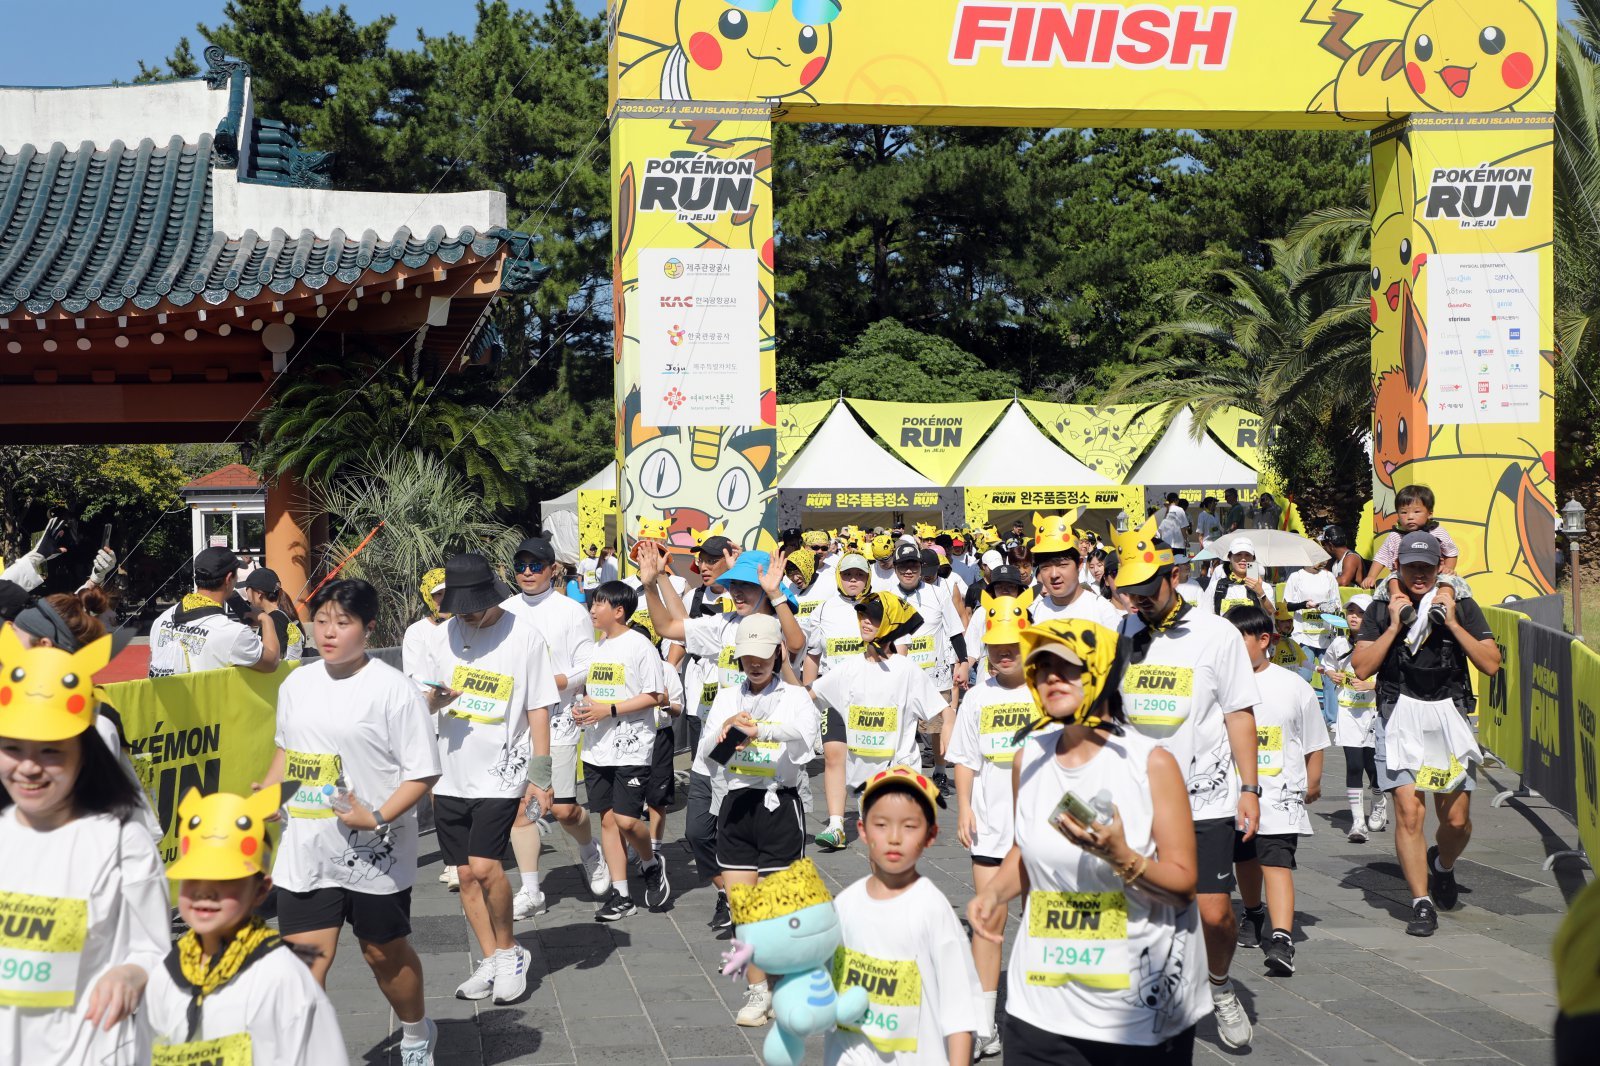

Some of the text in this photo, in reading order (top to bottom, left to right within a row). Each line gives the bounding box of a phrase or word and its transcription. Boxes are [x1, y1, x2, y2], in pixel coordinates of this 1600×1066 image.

[953, 5, 1232, 65] FINISH
[678, 106, 703, 114] JEJU
[704, 106, 739, 115] ISLAND
[1466, 117, 1490, 125] JEJU
[1490, 117, 1524, 125] ISLAND
[646, 154, 753, 175] POKÉMON
[1432, 163, 1533, 183] POKÉMON
[639, 176, 752, 211] RUN
[1425, 184, 1532, 218] RUN
[690, 213, 716, 221] JEJU
[1472, 219, 1497, 227] JEJU
[686, 263, 731, 273] 제주관광공사
[660, 296, 693, 308] KAC
[687, 332, 730, 341] 한국관광공사
[665, 363, 686, 375] Jeju
[902, 414, 962, 426] POKÉMON
[900, 427, 963, 448] RUN
[805, 497, 832, 507] RUN
[835, 492, 910, 508] 완주품증정소
[912, 496, 939, 506] RUN
[991, 495, 1016, 504] RUN
[1020, 491, 1091, 505] 완주품증정소
[1094, 494, 1119, 503] RUN
[1178, 493, 1202, 502] RUN
[834, 643, 860, 652] RUN
[467, 671, 500, 683] POKÉMON
[591, 670, 614, 681] RUN
[1139, 669, 1177, 677] POKÉMON
[462, 677, 499, 694] RUN
[1136, 676, 1177, 690] RUN
[457, 696, 496, 713] I-2637
[993, 707, 1030, 715] POKÉMON
[1134, 699, 1177, 712] I-2906
[857, 716, 885, 728] RUN
[991, 713, 1031, 728] RUN
[1530, 687, 1560, 757] RUN
[131, 720, 221, 765] KÉMON
[855, 733, 885, 746] I-2612
[734, 750, 771, 764] I-2854
[287, 763, 321, 781] RUN
[294, 789, 323, 805] 2944
[1046, 898, 1101, 910] POKÉMON
[1045, 909, 1101, 931] RUN
[1043, 946, 1105, 966] I-2947
[0, 957, 53, 983] 908
[845, 968, 899, 997] RUN
[1029, 974, 1046, 982] 4KM
[862, 1009, 899, 1032] 946
